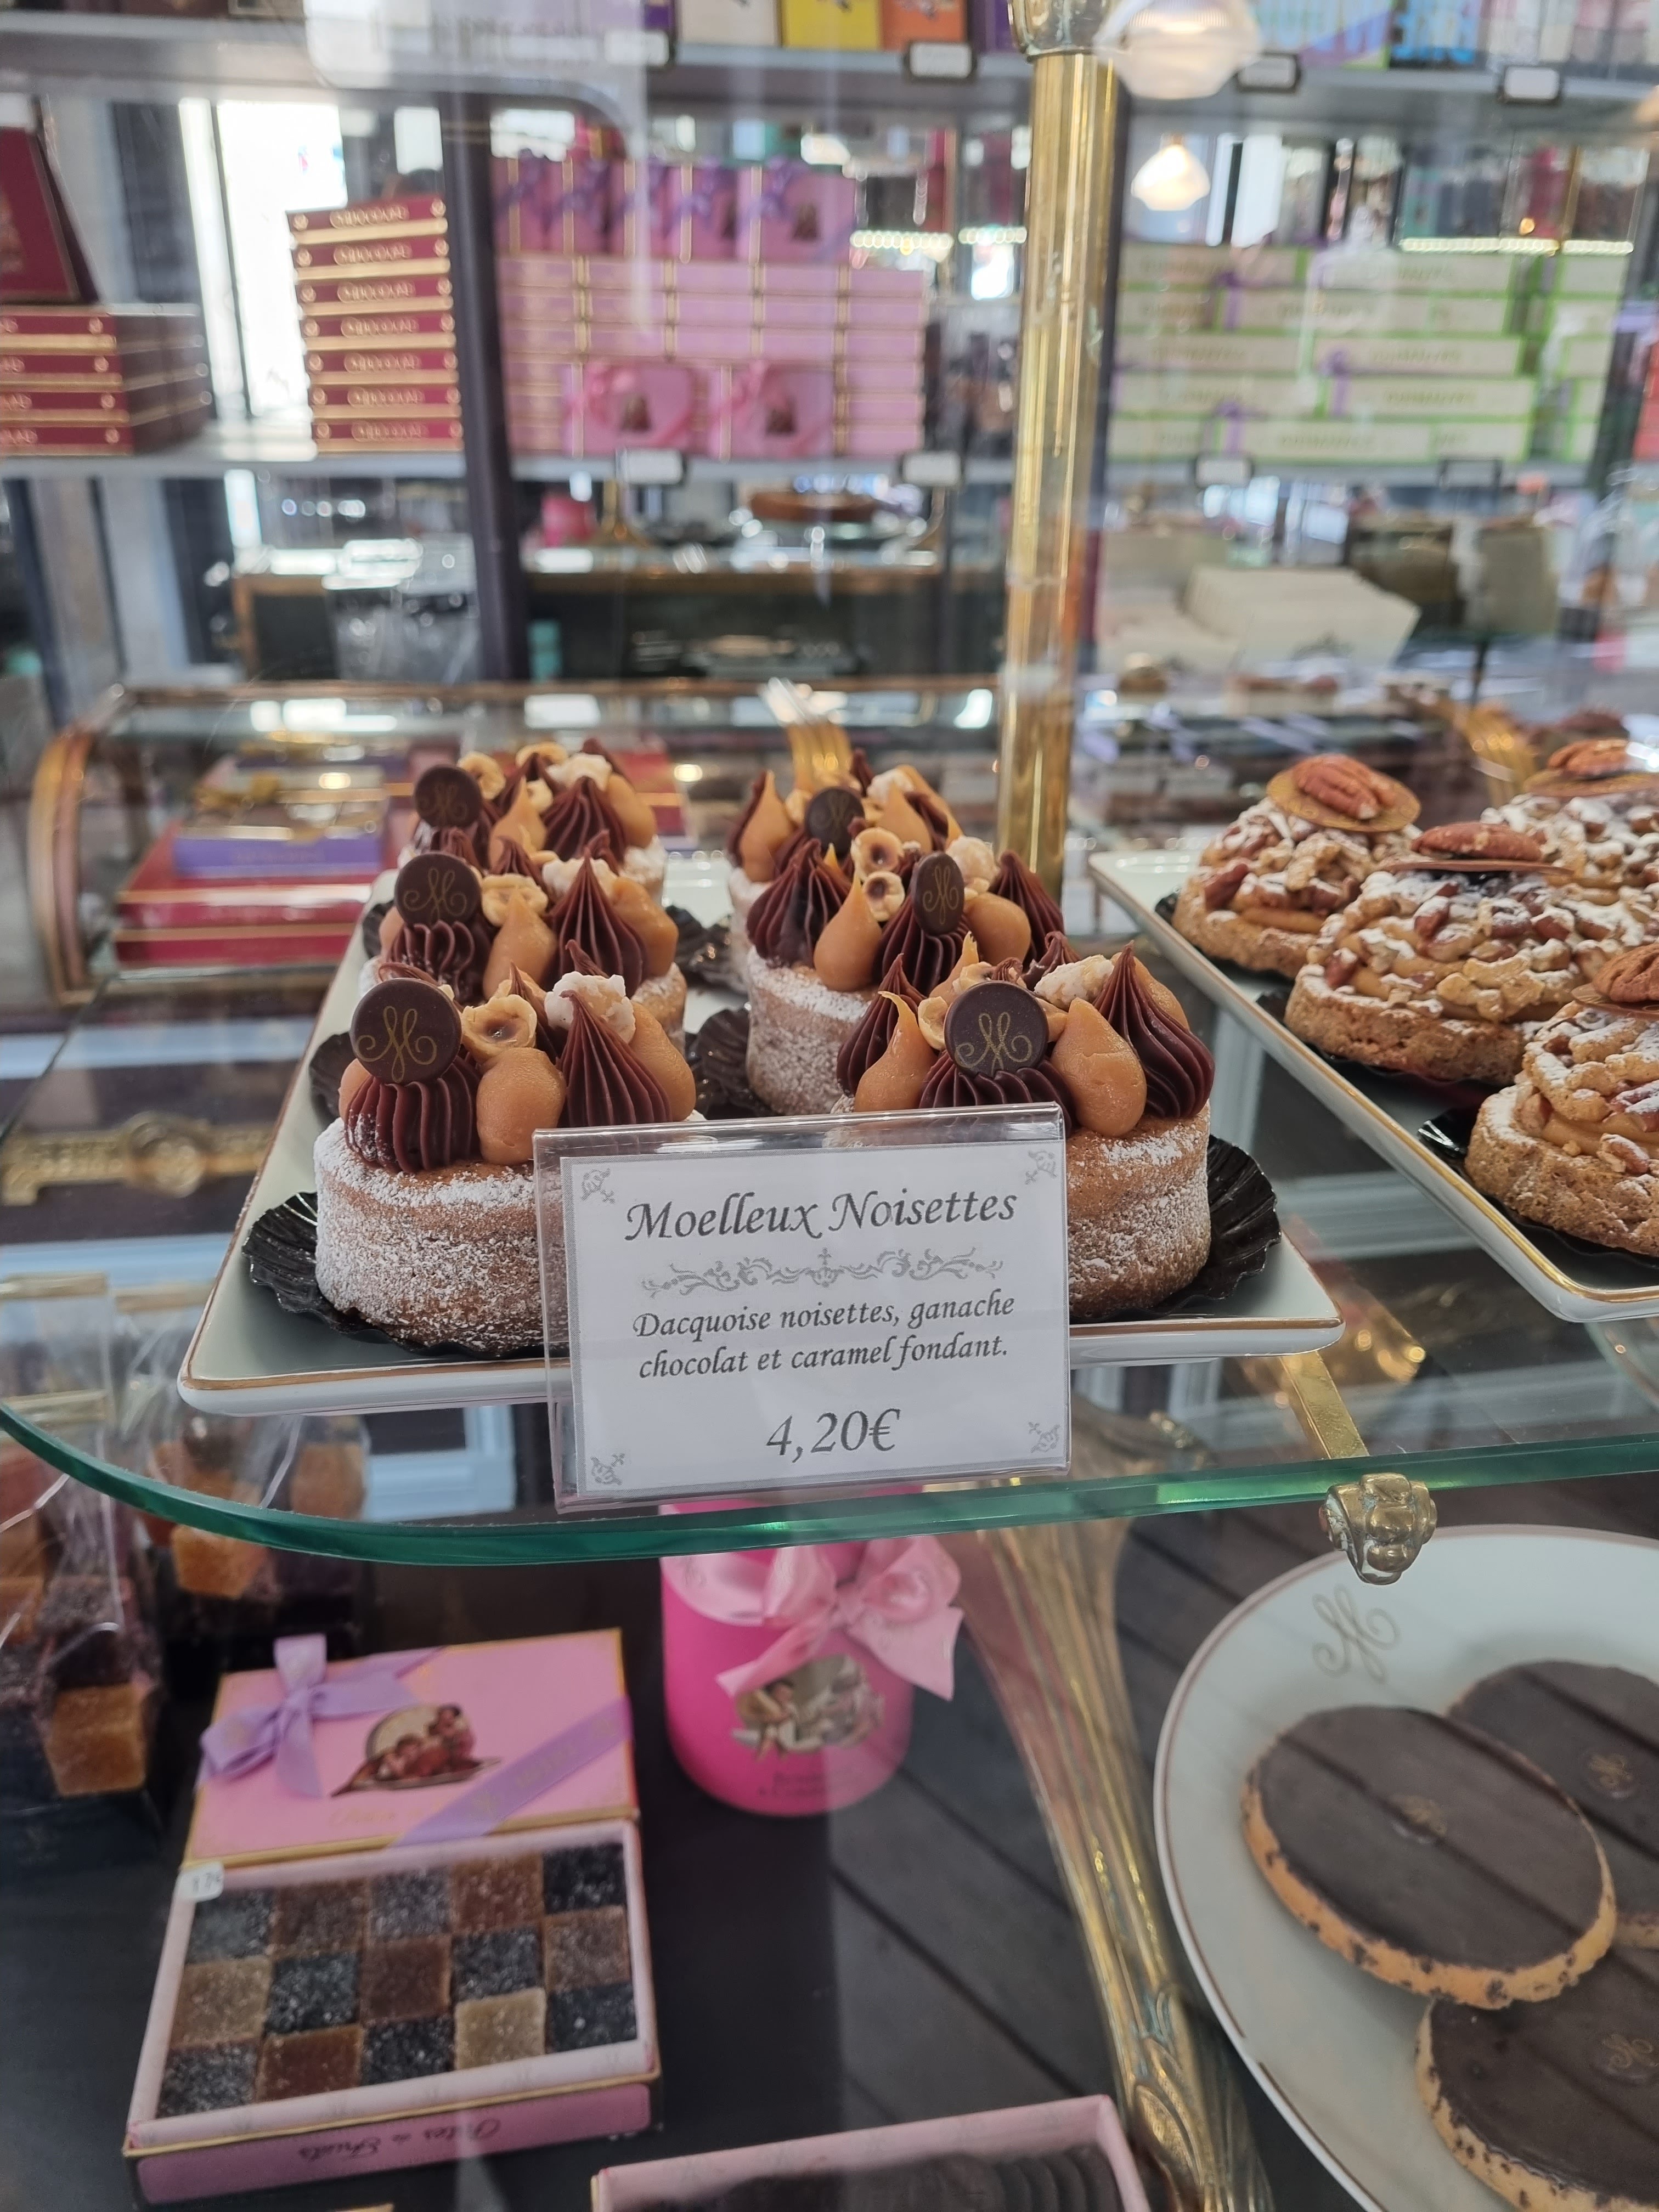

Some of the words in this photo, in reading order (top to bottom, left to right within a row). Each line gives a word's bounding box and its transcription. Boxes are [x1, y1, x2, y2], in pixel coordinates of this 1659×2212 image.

[623, 1191, 824, 1243] Moelleux
[827, 1187, 1018, 1234] Noisettes
[632, 1304, 771, 1342] Dacquoise
[780, 1301, 900, 1330] noisettes,
[909, 1288, 1016, 1330] ganache
[638, 1340, 748, 1379] chocolat
[757, 1346, 783, 1372] et
[790, 1335, 896, 1367] caramel
[890, 1331, 1009, 1373] fondant.
[766, 1407, 902, 1464] 4,20€
